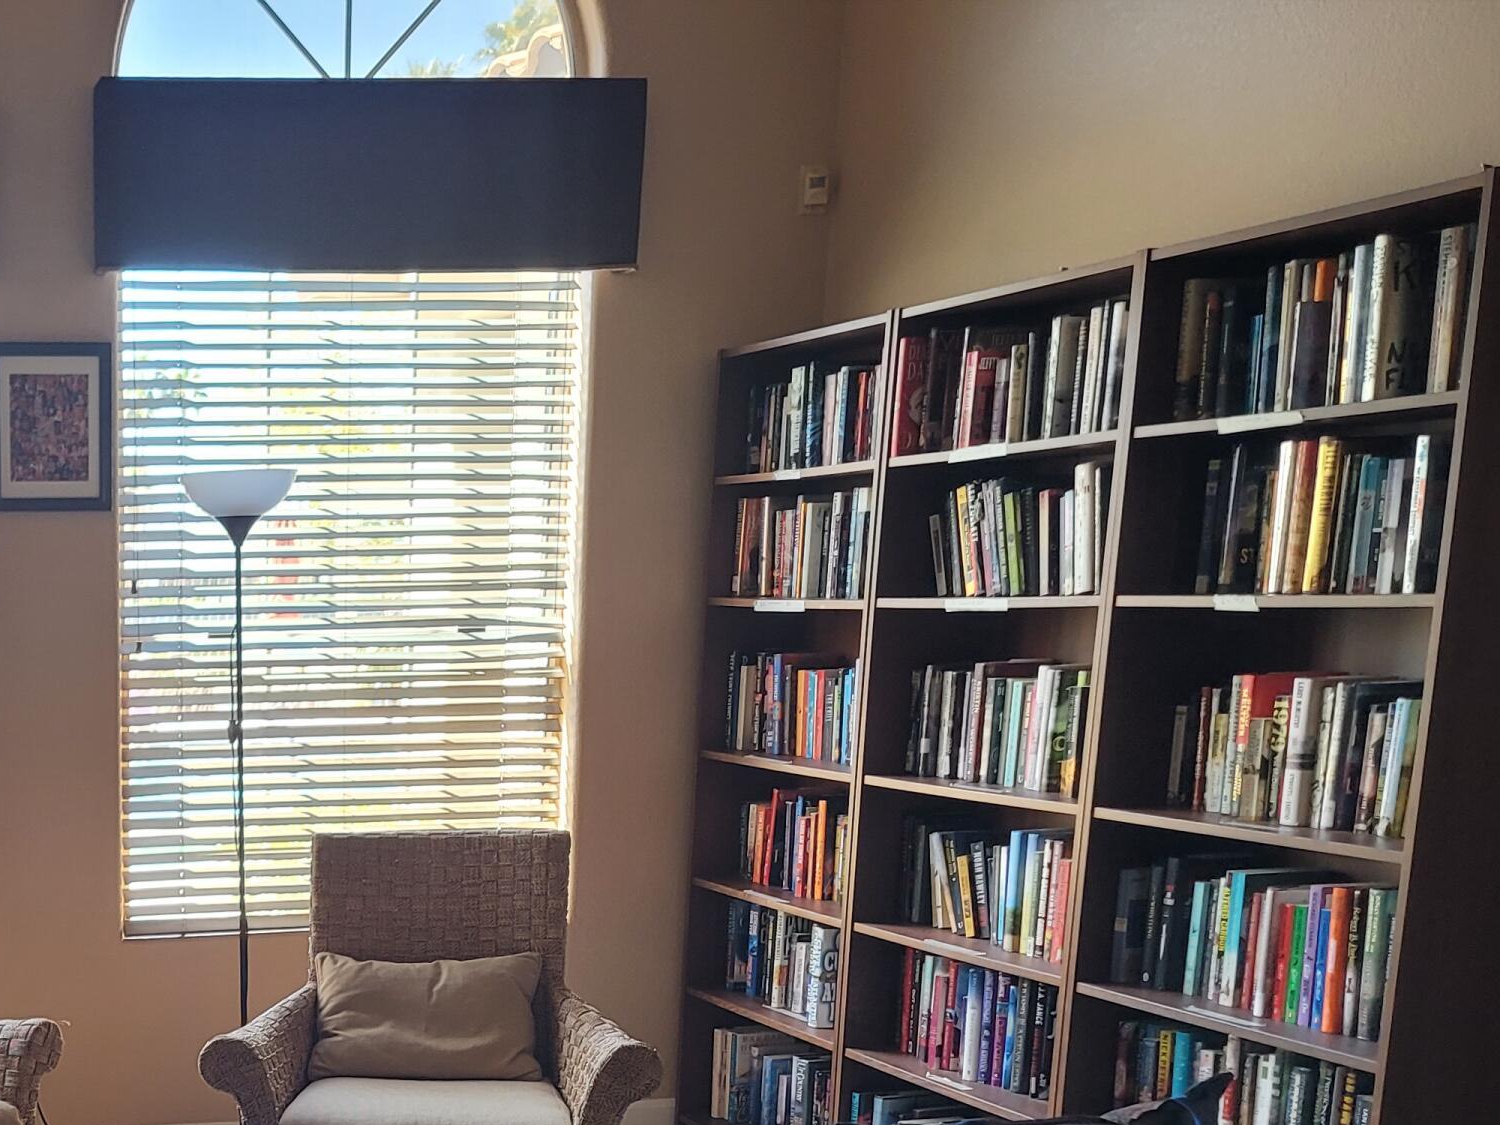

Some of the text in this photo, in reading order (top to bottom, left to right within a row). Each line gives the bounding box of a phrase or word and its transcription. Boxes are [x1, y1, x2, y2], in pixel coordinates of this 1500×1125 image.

[1269, 698, 1290, 753] 1979
[972, 851, 985, 905] NOAH HAWLEY
[1033, 1001, 1044, 1025] JANCE
[1159, 1033, 1171, 1058] NICK
